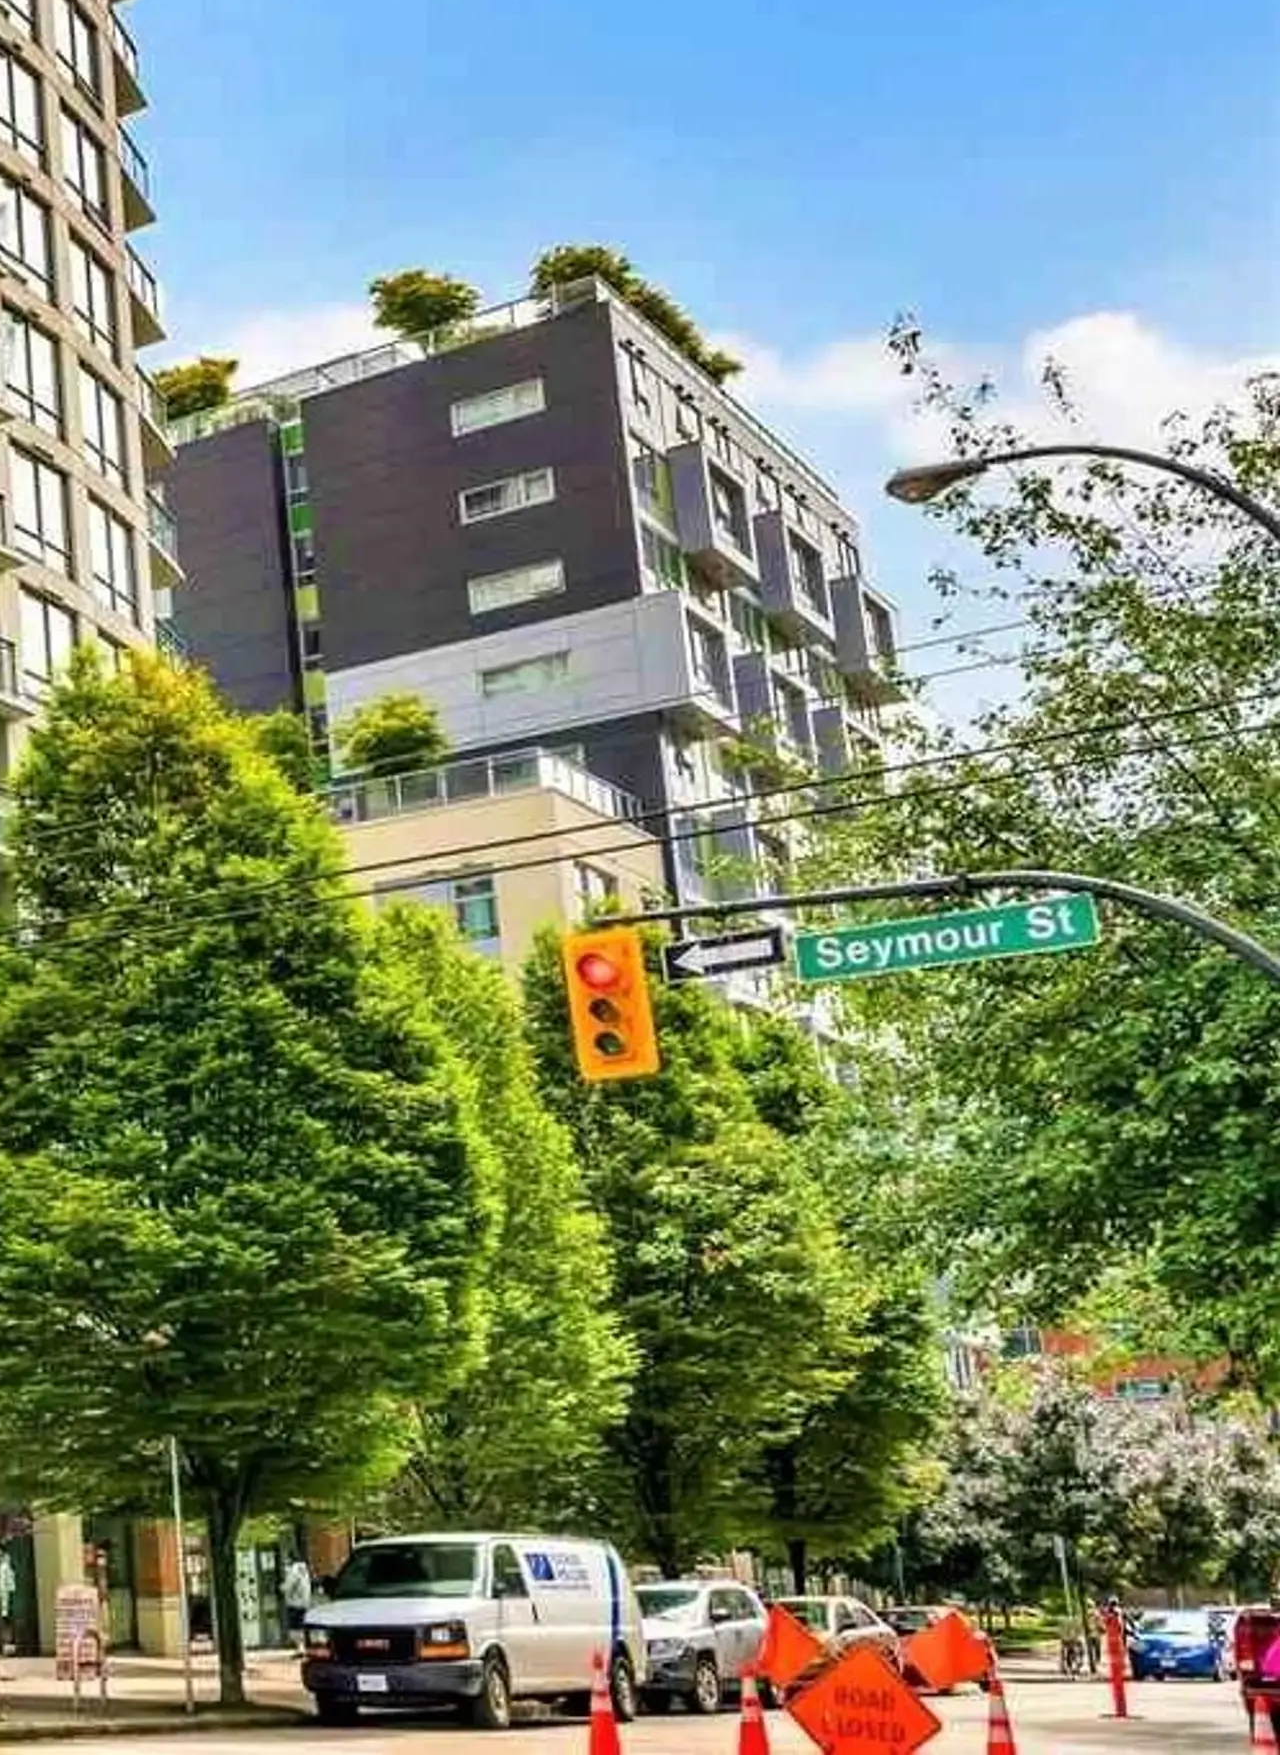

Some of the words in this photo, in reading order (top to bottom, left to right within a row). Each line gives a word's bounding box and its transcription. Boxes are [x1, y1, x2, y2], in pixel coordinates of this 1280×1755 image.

[815, 920, 1004, 968] Seymour
[1025, 903, 1076, 939] St
[833, 1684, 896, 1712] ROAD
